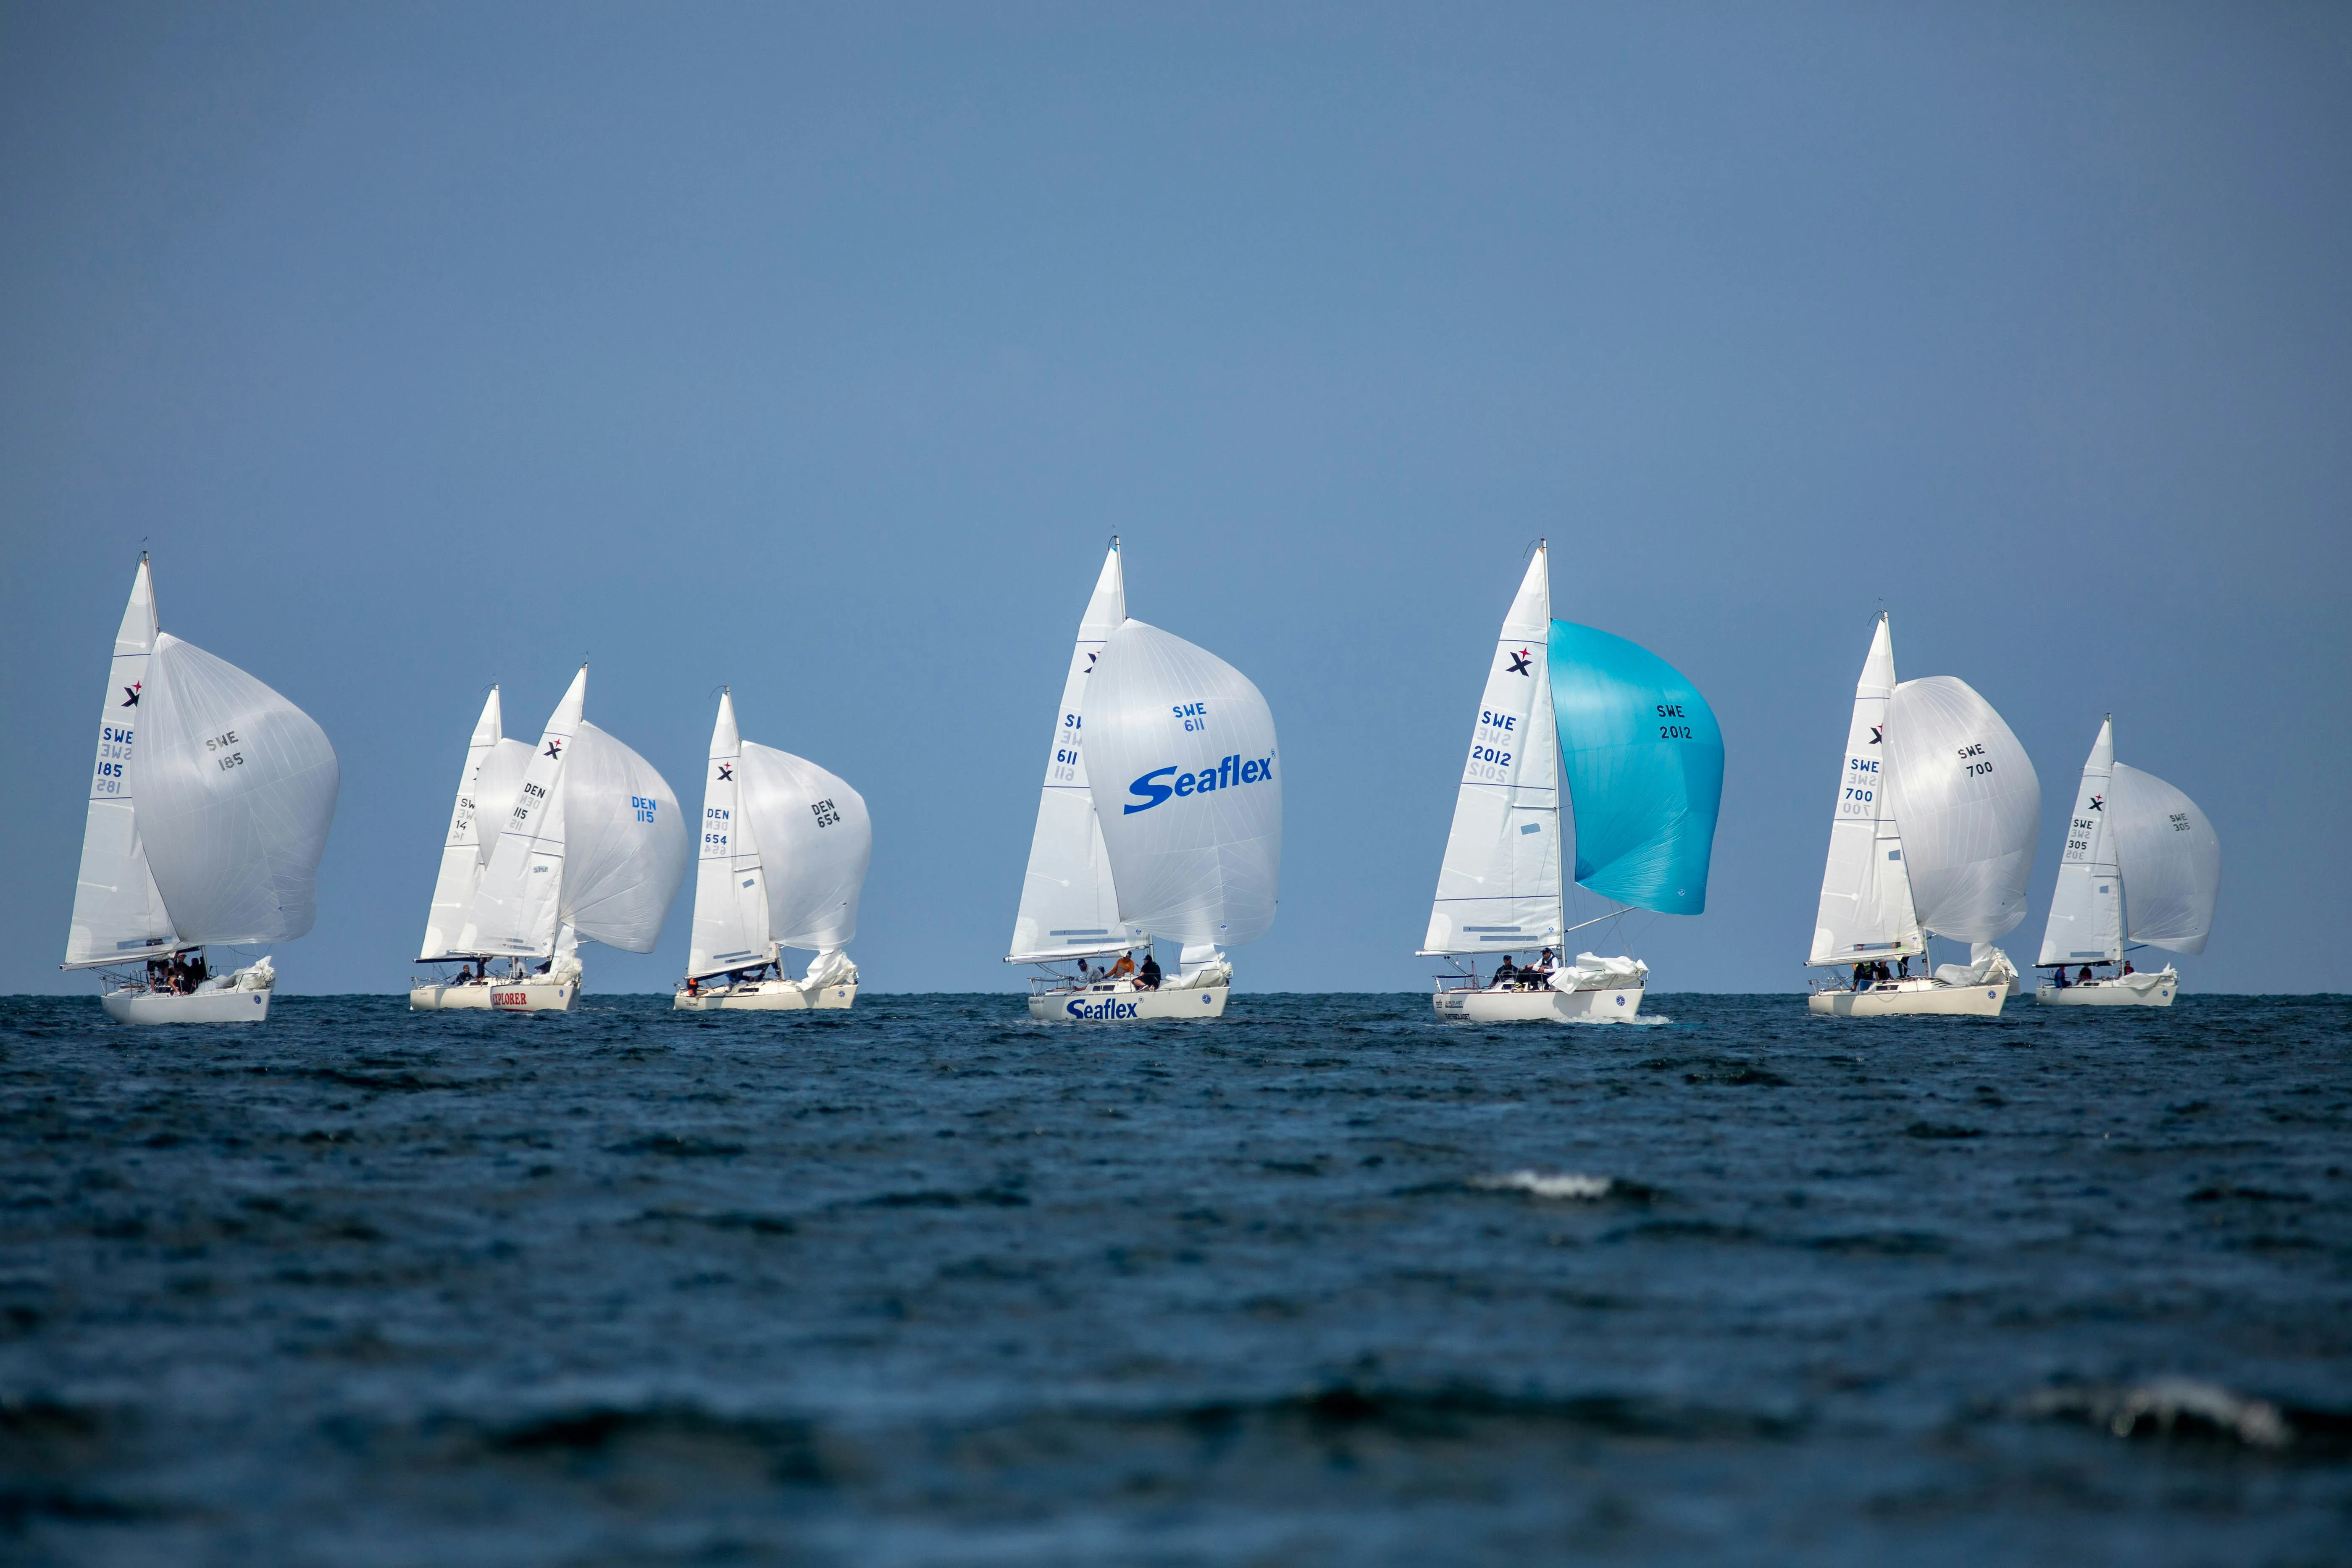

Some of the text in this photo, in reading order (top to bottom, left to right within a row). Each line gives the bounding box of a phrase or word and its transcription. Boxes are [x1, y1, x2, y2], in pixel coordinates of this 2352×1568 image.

[1172, 702, 1207, 718] SWE
[1657, 704, 1685, 718] SWE
[1184, 718, 1204, 732] 611
[1482, 711, 1516, 731] SWE
[103, 728, 133, 744] SWE
[1660, 725, 1692, 739] 2012
[206, 731, 239, 751] SWE
[1057, 749, 1077, 765] 611
[1472, 746, 1511, 767] 2012
[1958, 743, 1985, 759] SWE
[218, 752, 244, 771] 185
[1851, 759, 1879, 773] SWE
[97, 762, 123, 777] 185
[1966, 762, 1992, 777] 700
[524, 783, 546, 798] DEN
[1123, 754, 1272, 815] Seaflex
[1845, 788, 1873, 802] 700
[461, 798, 475, 809] SW
[632, 796, 656, 811] DEN
[811, 798, 835, 816] DEN
[513, 807, 528, 819] 115
[637, 810, 654, 823] 115
[707, 809, 729, 819] DEN
[817, 811, 840, 828] 654
[2169, 813, 2188, 822] SWE
[457, 820, 467, 830] 14
[2073, 819, 2094, 829] SWE
[2173, 822, 2190, 831] 305
[705, 833, 727, 845] 654
[2068, 840, 2087, 850] 305
[493, 993, 527, 1005] EXPLORER
